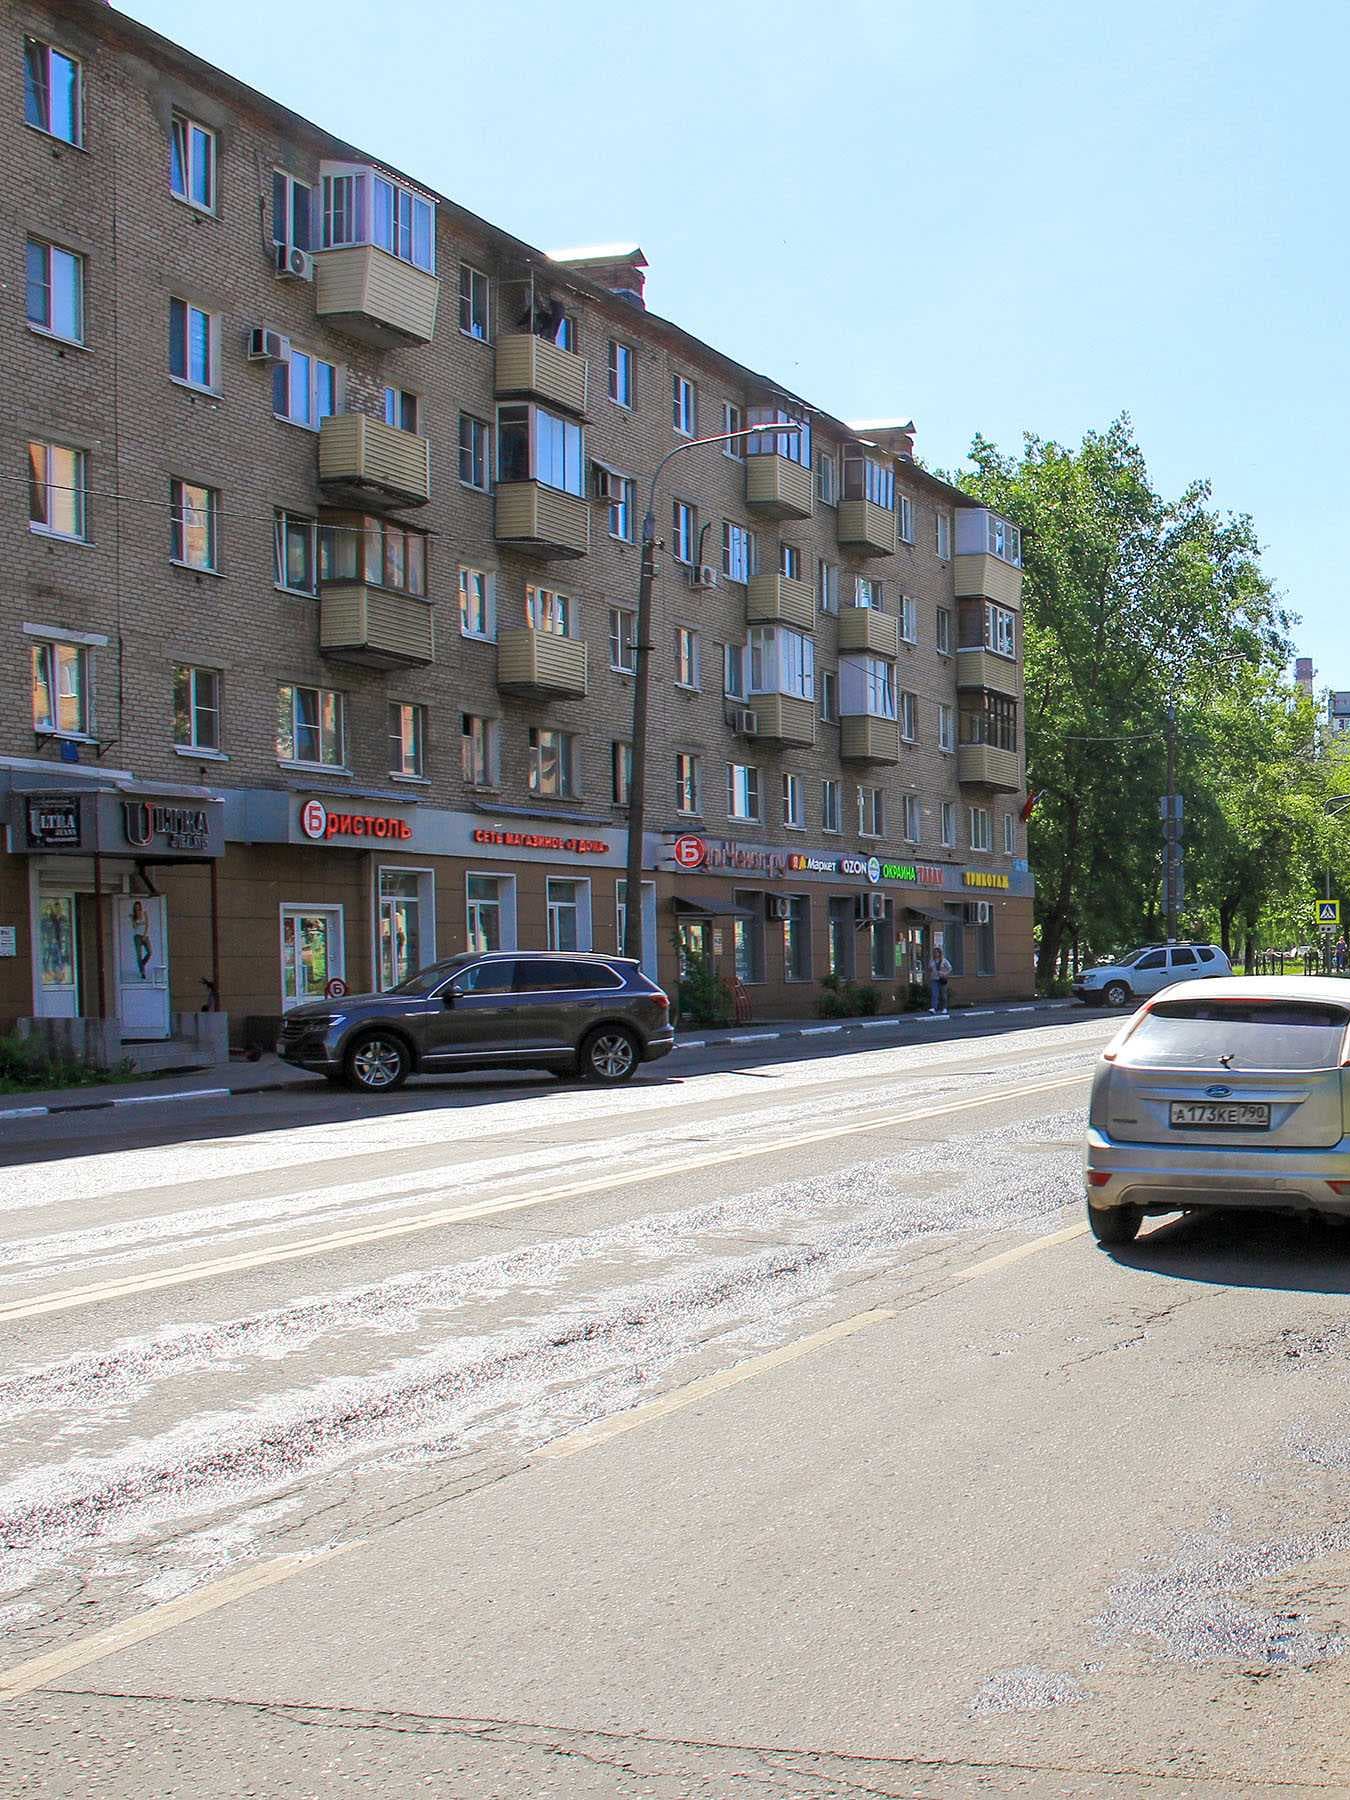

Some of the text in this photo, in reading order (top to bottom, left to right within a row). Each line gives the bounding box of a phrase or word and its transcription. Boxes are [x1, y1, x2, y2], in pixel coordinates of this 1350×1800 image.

[124, 800, 211, 847] ULTRA
[303, 801, 413, 840] Бристоль
[474, 830, 503, 845] СЕТЬ
[681, 840, 699, 862] Б
[807, 857, 836, 872] Маркет
[843, 862, 867, 874] OZON
[882, 864, 916, 881] ОКРАИНА
[965, 871, 1009, 889] ТРИКОТАЖ
[1239, 1105, 1265, 1119] 790
